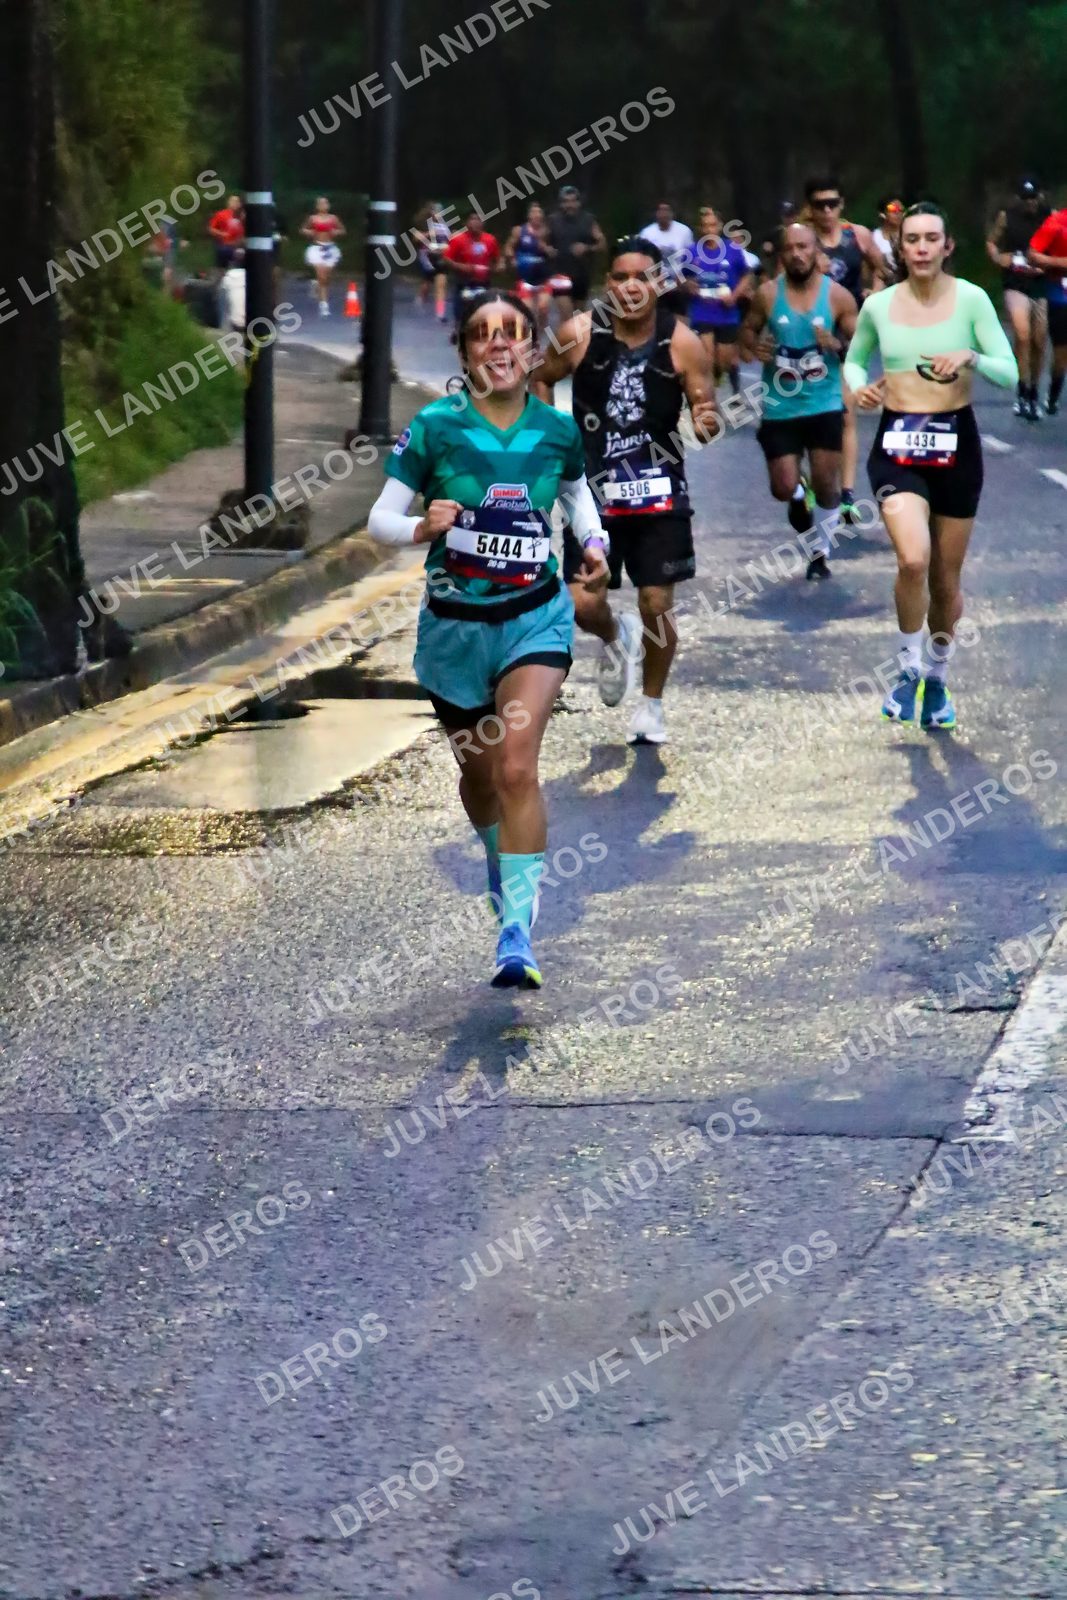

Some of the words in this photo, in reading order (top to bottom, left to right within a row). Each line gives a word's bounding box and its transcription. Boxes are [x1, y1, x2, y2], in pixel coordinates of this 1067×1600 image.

[606, 431, 621, 441] LA
[905, 433, 936, 448] 4434
[620, 480, 650, 498] 5506
[476, 534, 522, 558] 5444
